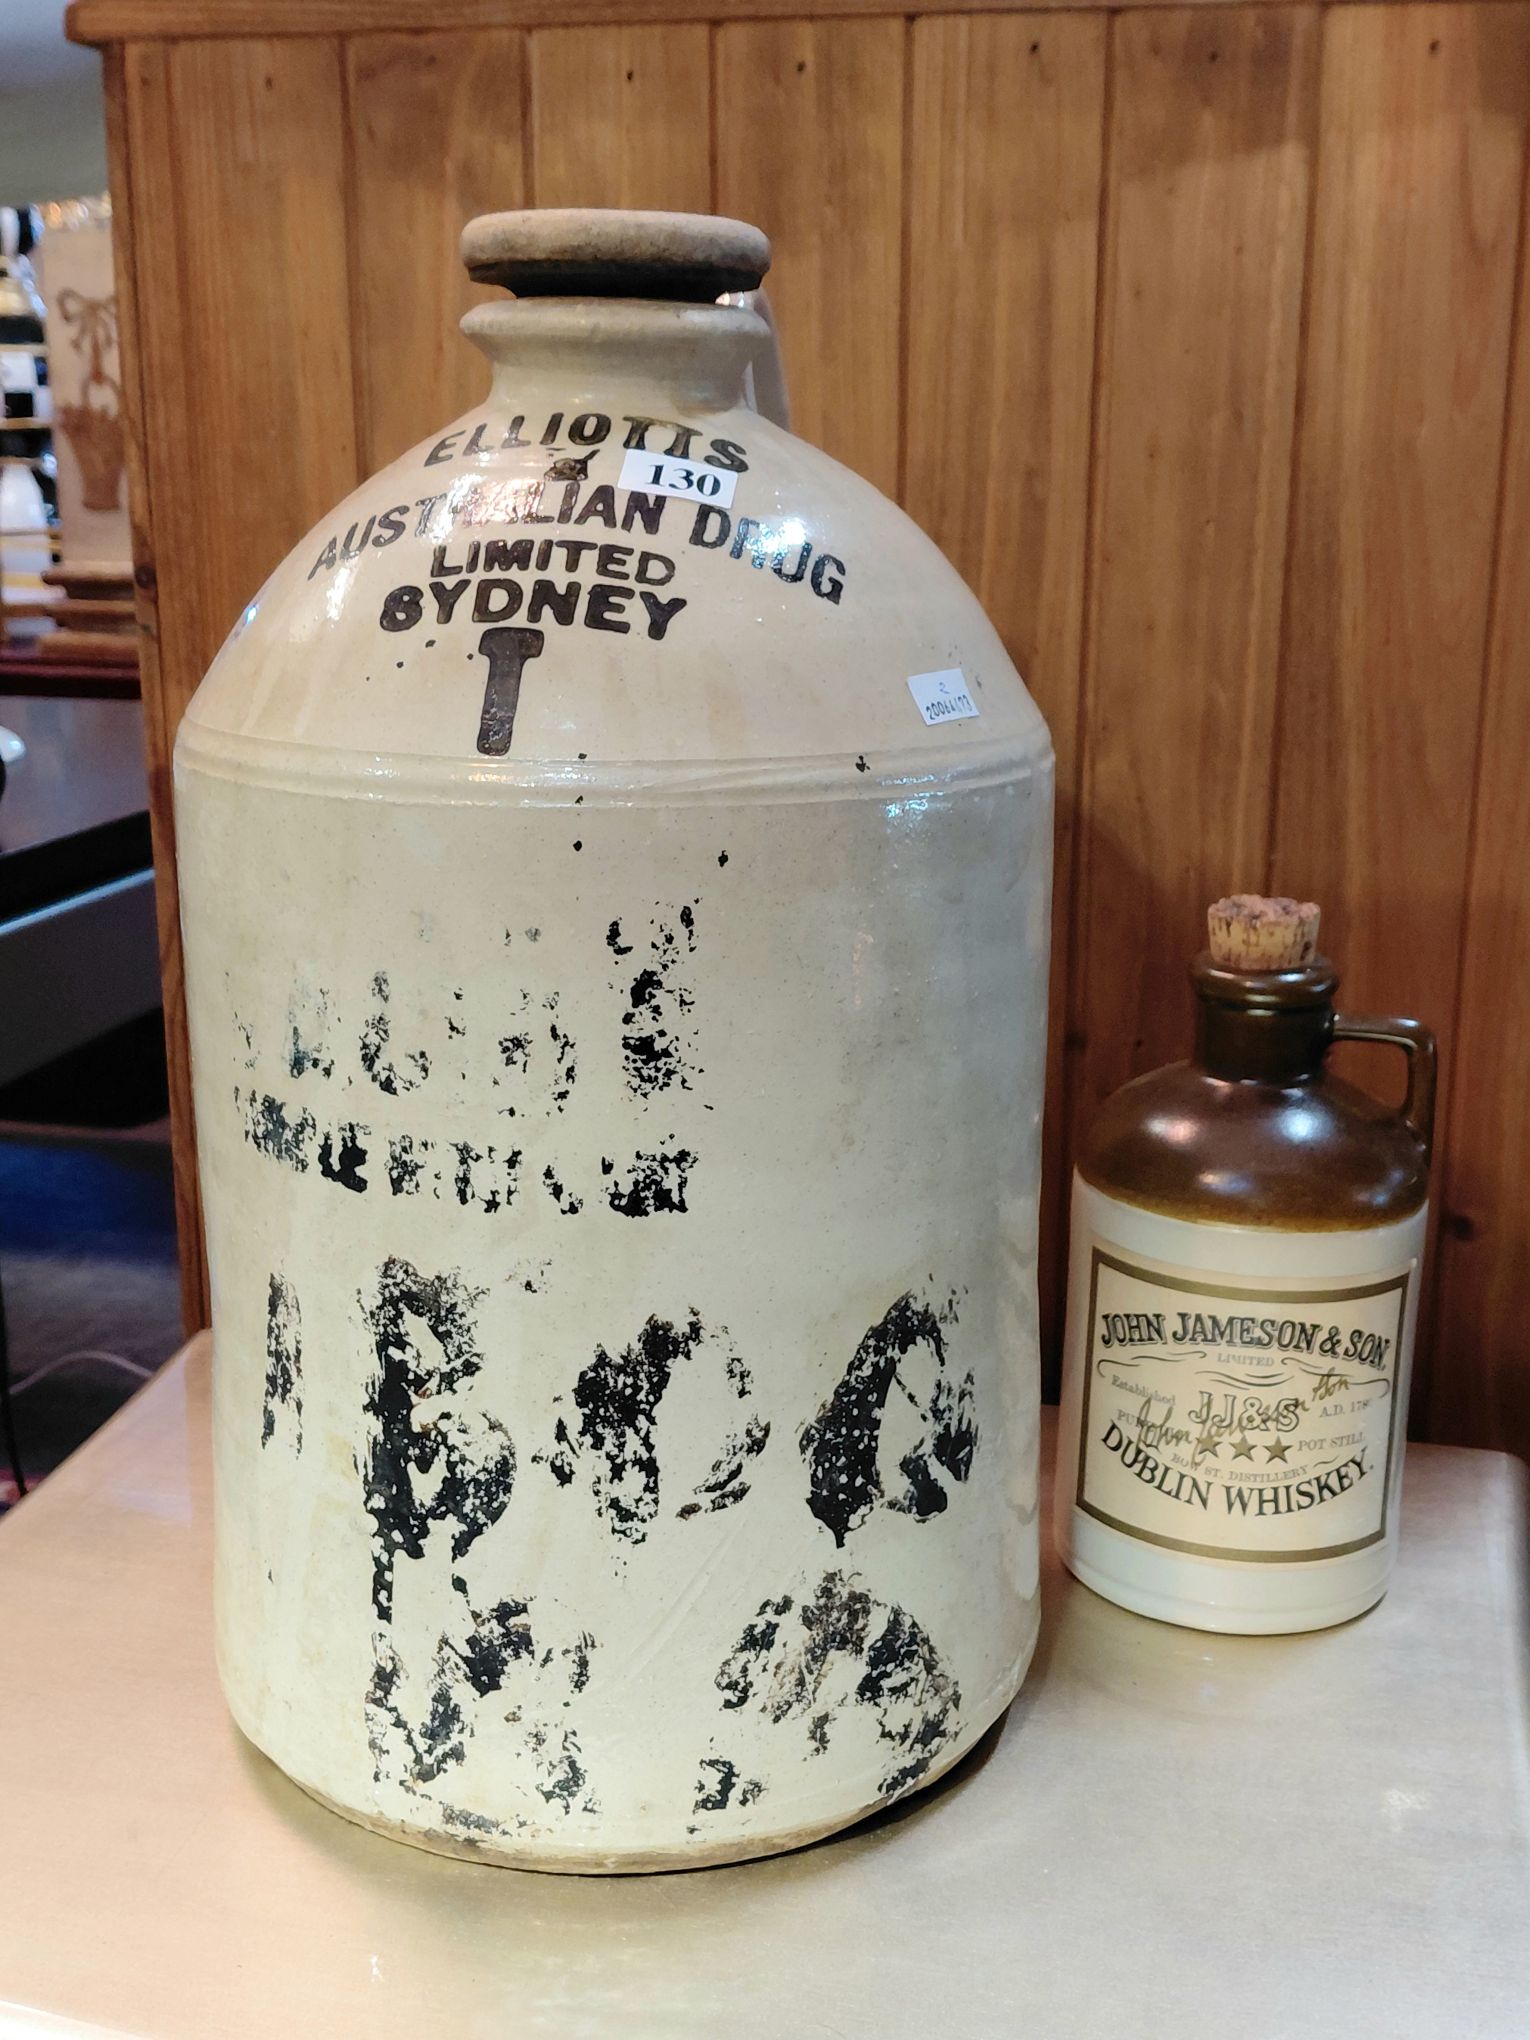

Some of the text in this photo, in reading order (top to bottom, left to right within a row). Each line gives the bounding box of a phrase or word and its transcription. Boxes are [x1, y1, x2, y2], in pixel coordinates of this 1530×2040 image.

[424, 413, 749, 473] ELLIOTTS
[649, 463, 721, 497] 130
[308, 479, 846, 605] AUSTLIAN DRUG
[430, 539, 676, 586] LIMITED
[379, 578, 688, 640] SYDNEY
[1101, 1313, 1166, 1348] JOHN
[1172, 1312, 1322, 1354] JAMESON
[1319, 1325, 1342, 1358] &
[1217, 1352, 1275, 1368] LIMITED
[1111, 1374, 1177, 1407] Established
[1297, 1438, 1330, 1452] POT
[1329, 1432, 1366, 1447] STILL
[1101, 1419, 1374, 1517] DUBLIN WHISKEY.
[1204, 1466, 1224, 1480] ST.
[1229, 1464, 1308, 1484] DISTILLERY
